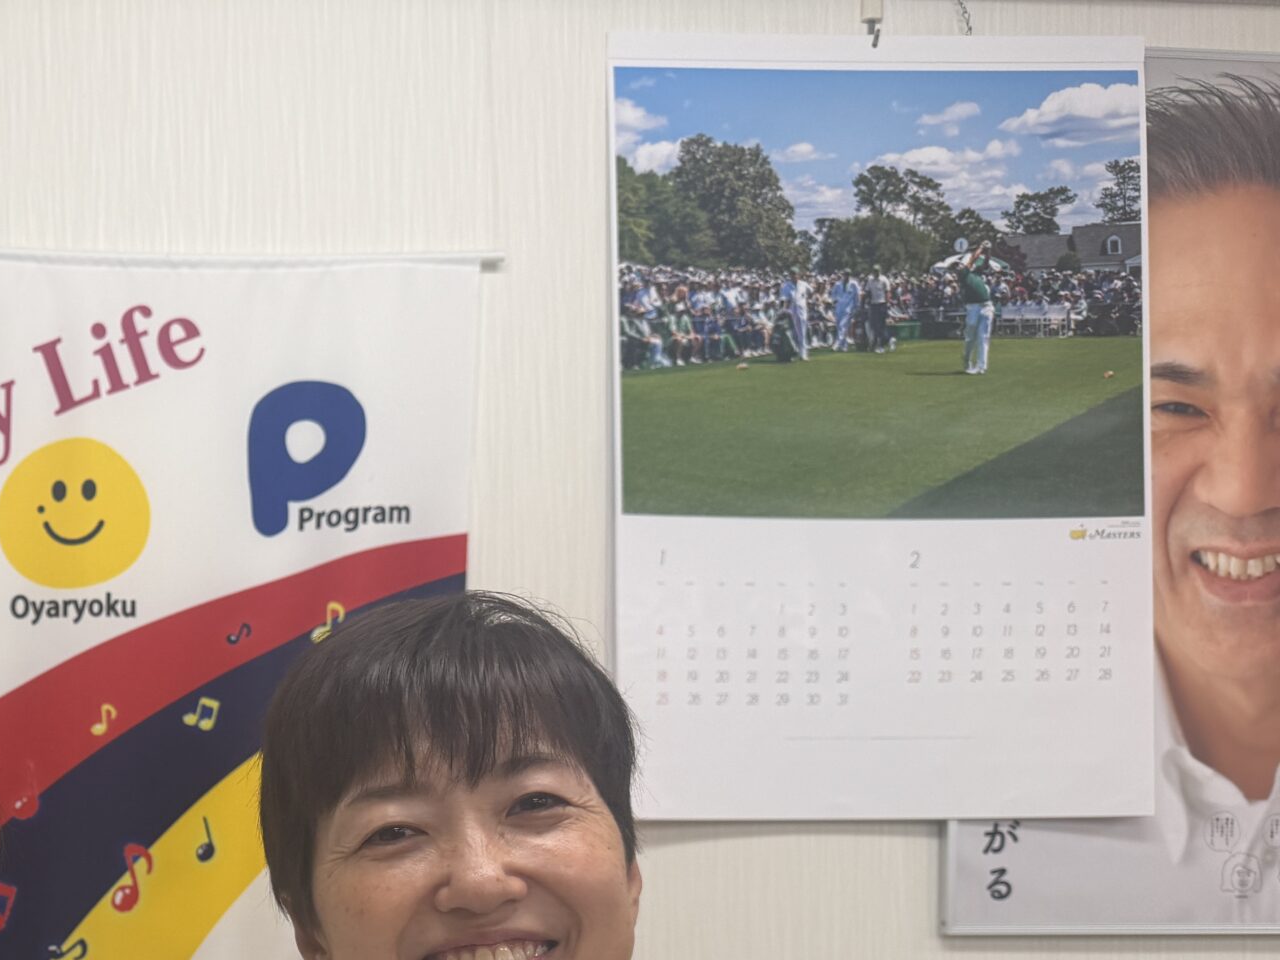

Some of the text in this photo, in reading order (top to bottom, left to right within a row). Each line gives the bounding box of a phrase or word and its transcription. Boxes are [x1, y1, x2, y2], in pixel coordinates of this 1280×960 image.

[32, 304, 206, 416] Life
[296, 501, 411, 532] Program
[909, 551, 920, 569] 2
[9, 591, 137, 625] Oyaryoku
[982, 820, 1020, 900] がる
